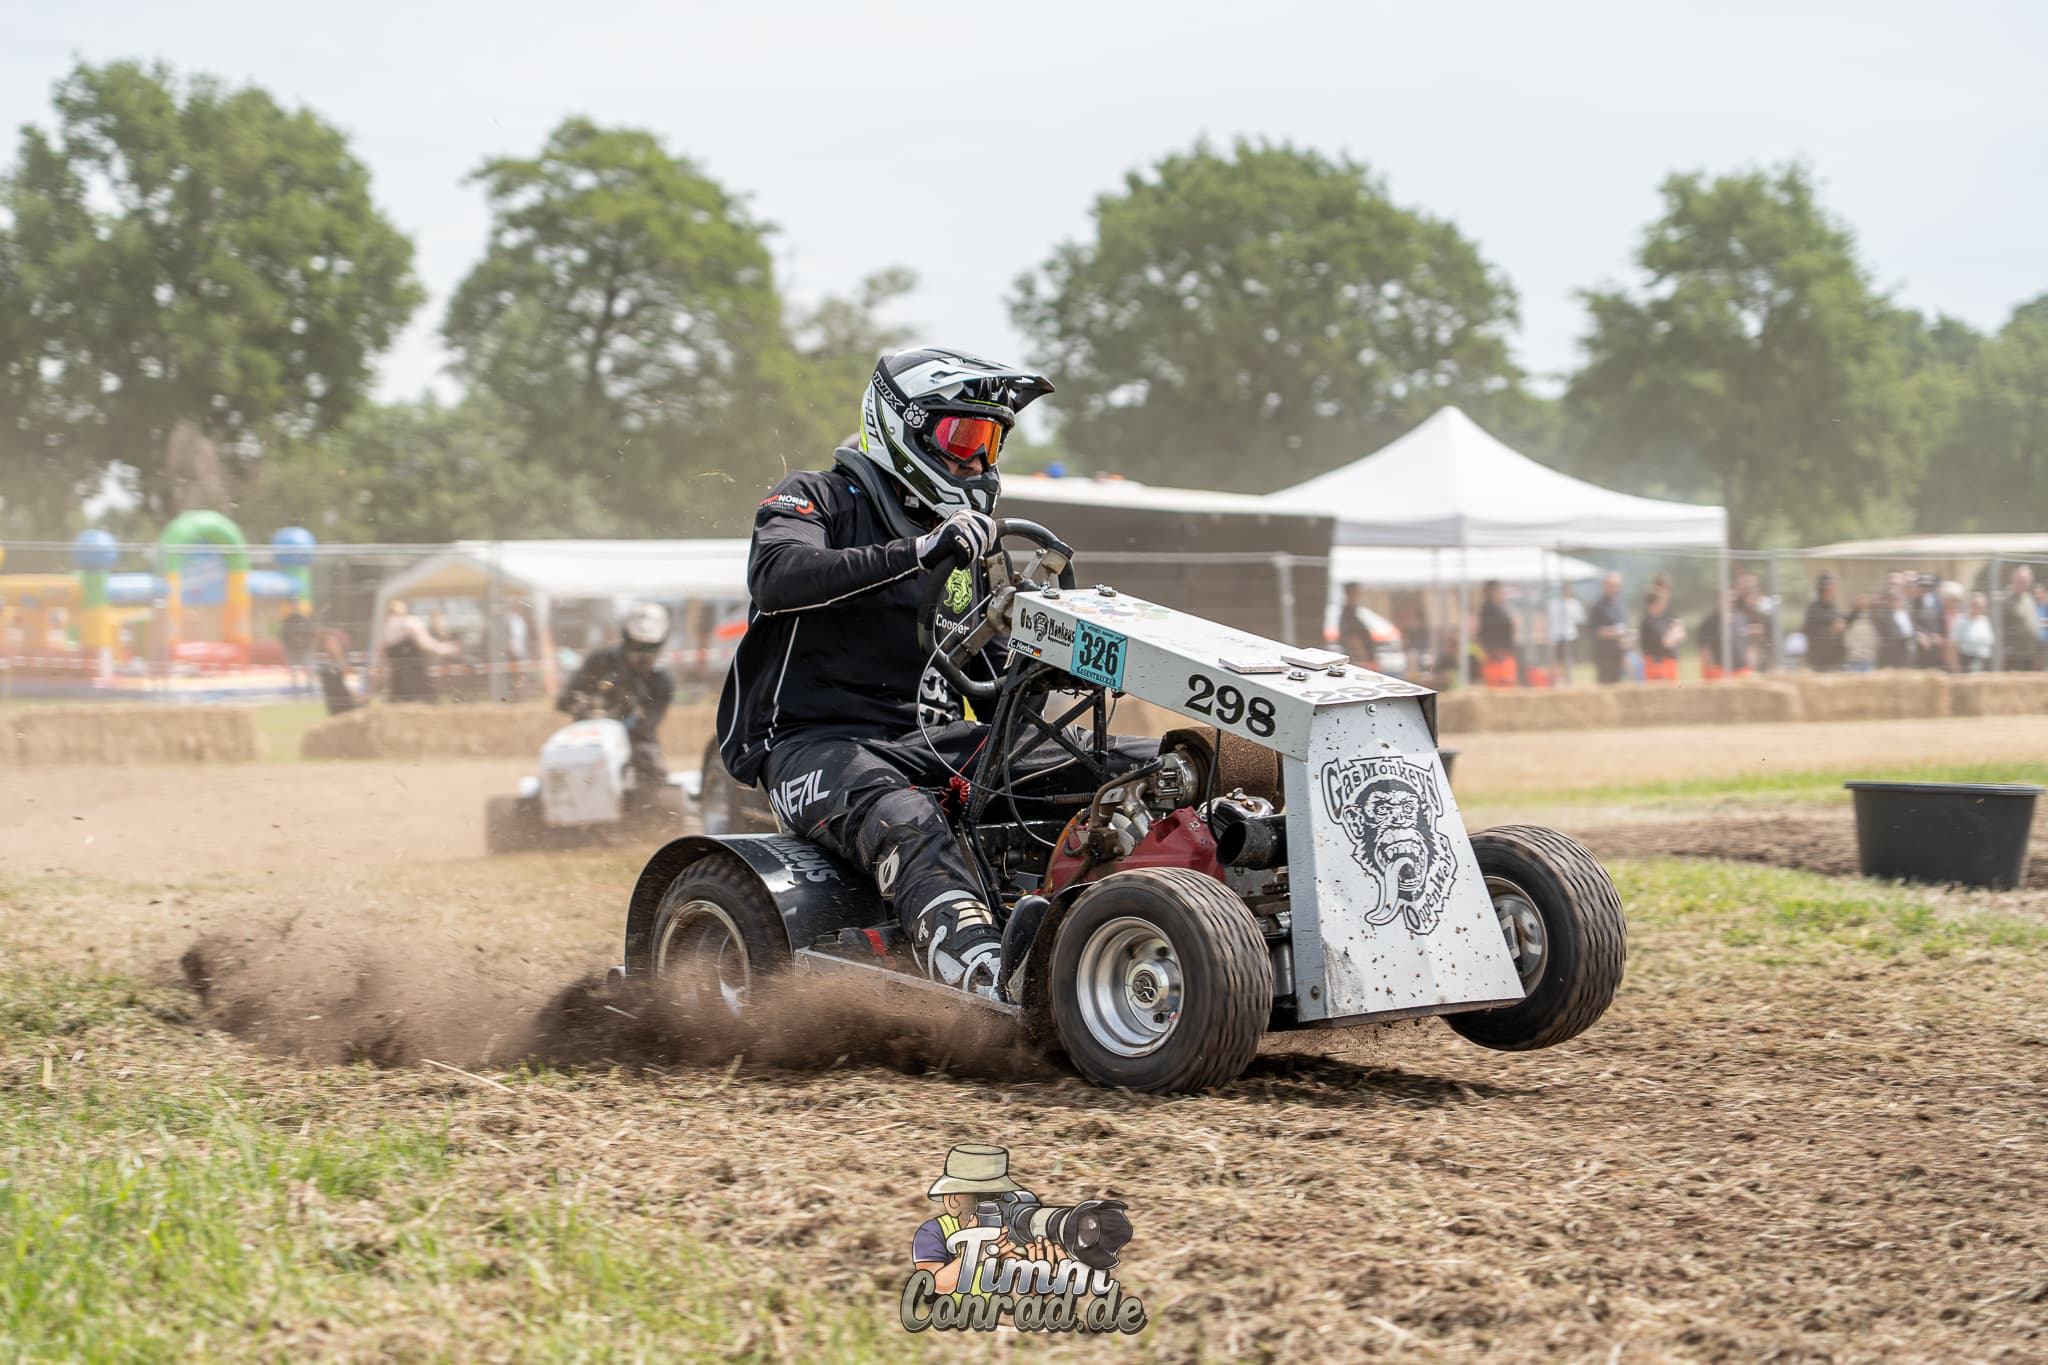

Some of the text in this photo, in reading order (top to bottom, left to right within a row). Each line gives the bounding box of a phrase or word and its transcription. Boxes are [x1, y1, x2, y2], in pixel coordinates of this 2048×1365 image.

[1079, 631, 1119, 675] 326
[1184, 674, 1276, 738] 298
[1300, 683, 1423, 702] 298
[769, 769, 830, 823] NEAL
